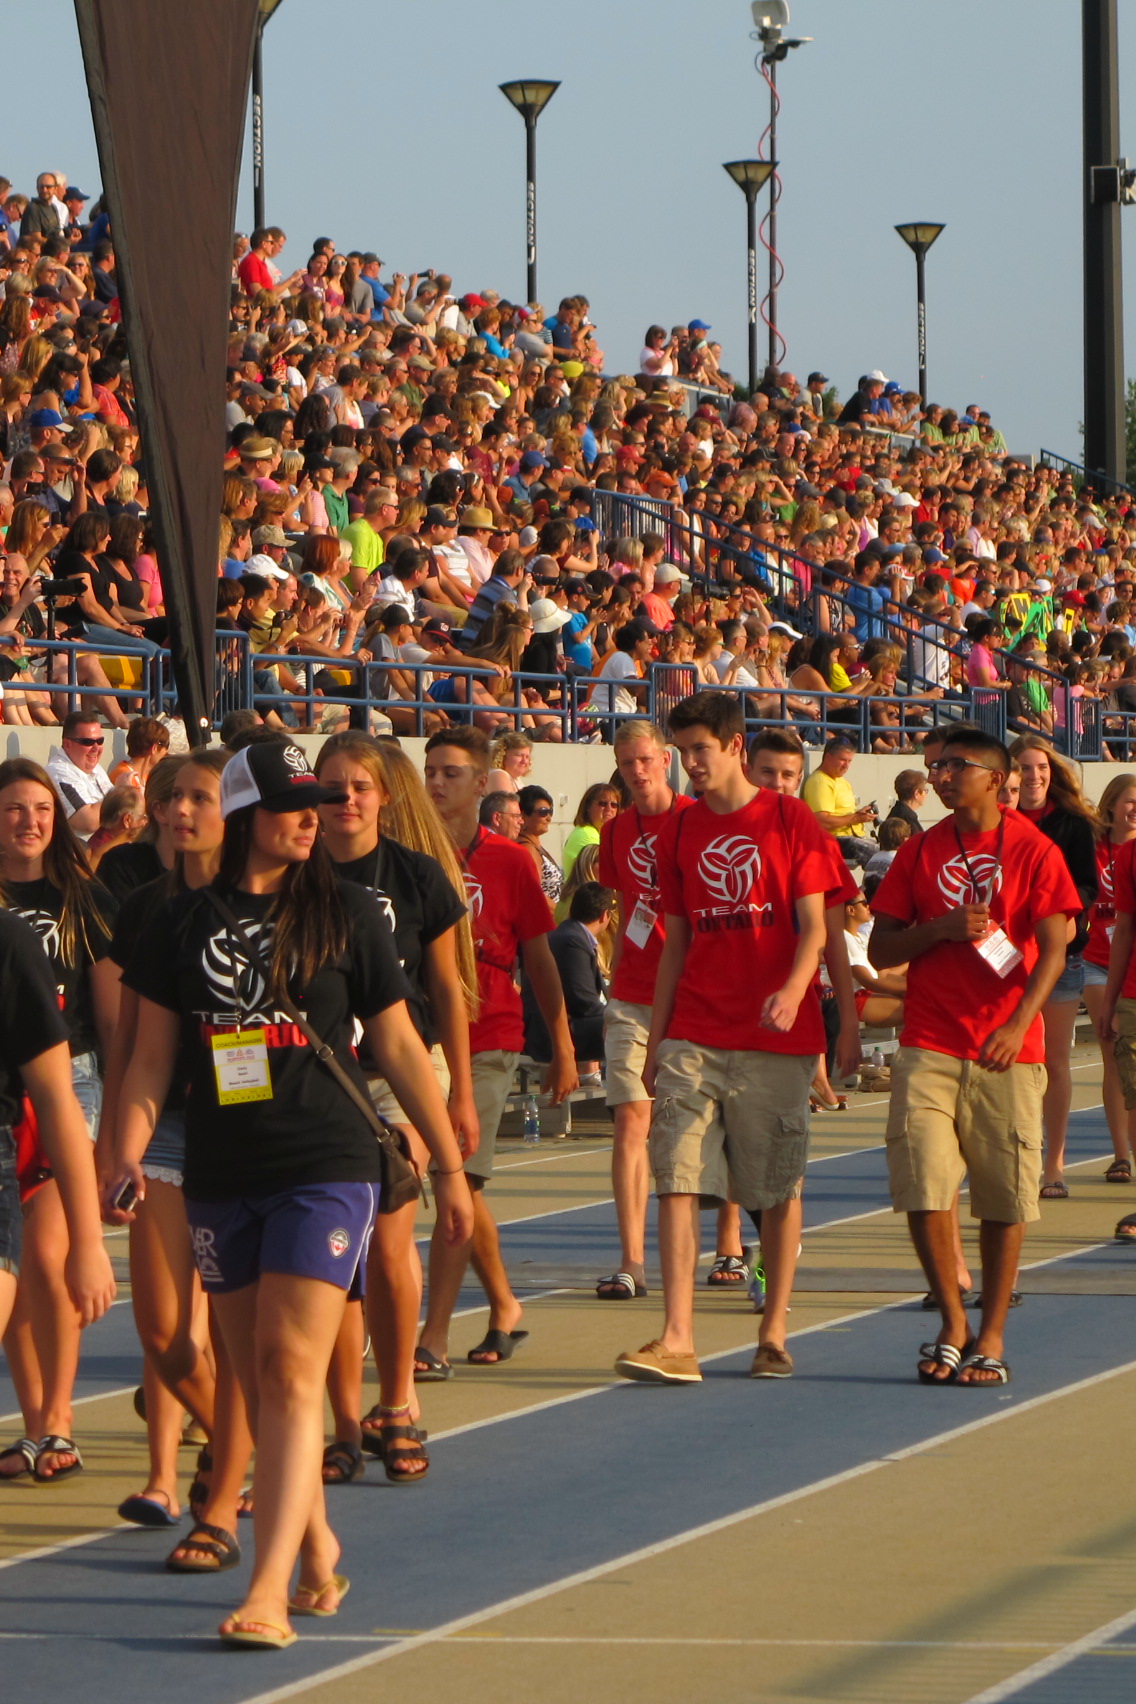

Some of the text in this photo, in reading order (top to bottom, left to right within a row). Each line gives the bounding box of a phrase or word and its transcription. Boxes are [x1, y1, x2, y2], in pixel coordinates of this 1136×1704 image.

[253, 94, 261, 167] SECTION
[693, 902, 773, 918] TEAM
[191, 1011, 308, 1025] TEAM
